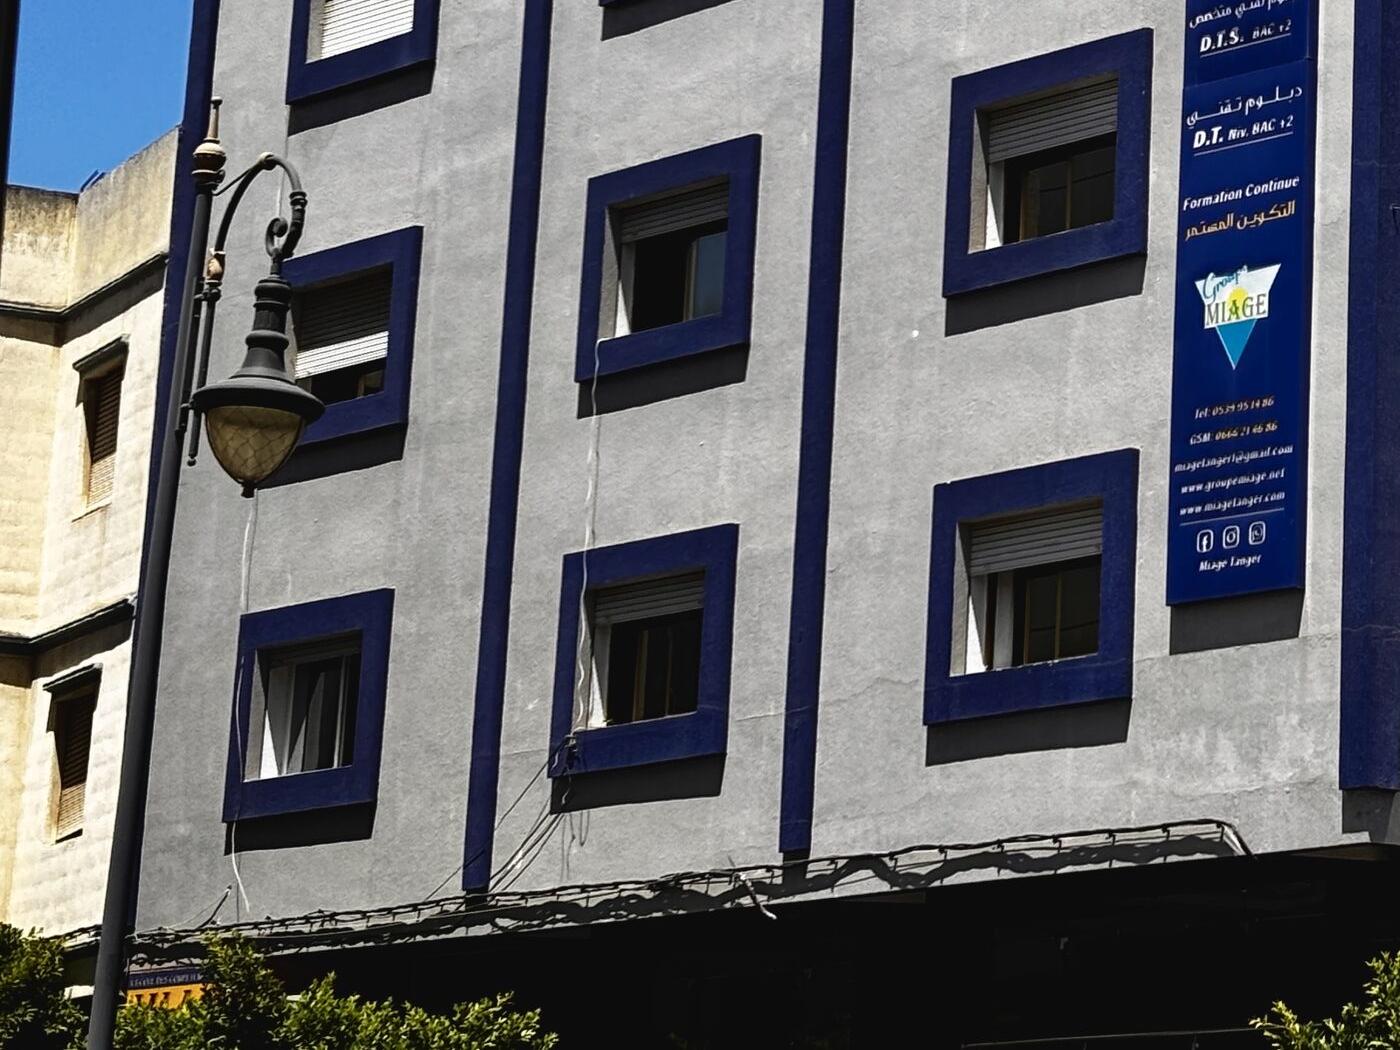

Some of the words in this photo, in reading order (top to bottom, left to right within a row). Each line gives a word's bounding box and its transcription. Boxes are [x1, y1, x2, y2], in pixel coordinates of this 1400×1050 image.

[1186, 97, 1242, 129] تقني
[1244, 85, 1303, 116] دبلوم
[1193, 126, 1224, 149] D.T.
[1252, 118, 1275, 135] BAC
[1280, 115, 1294, 129] +2
[1183, 188, 1242, 211] Formation
[1245, 176, 1300, 197] Continue
[1184, 212, 1234, 242] المستمر
[1236, 200, 1296, 230] التكوين
[1206, 293, 1266, 326] MIAGE
